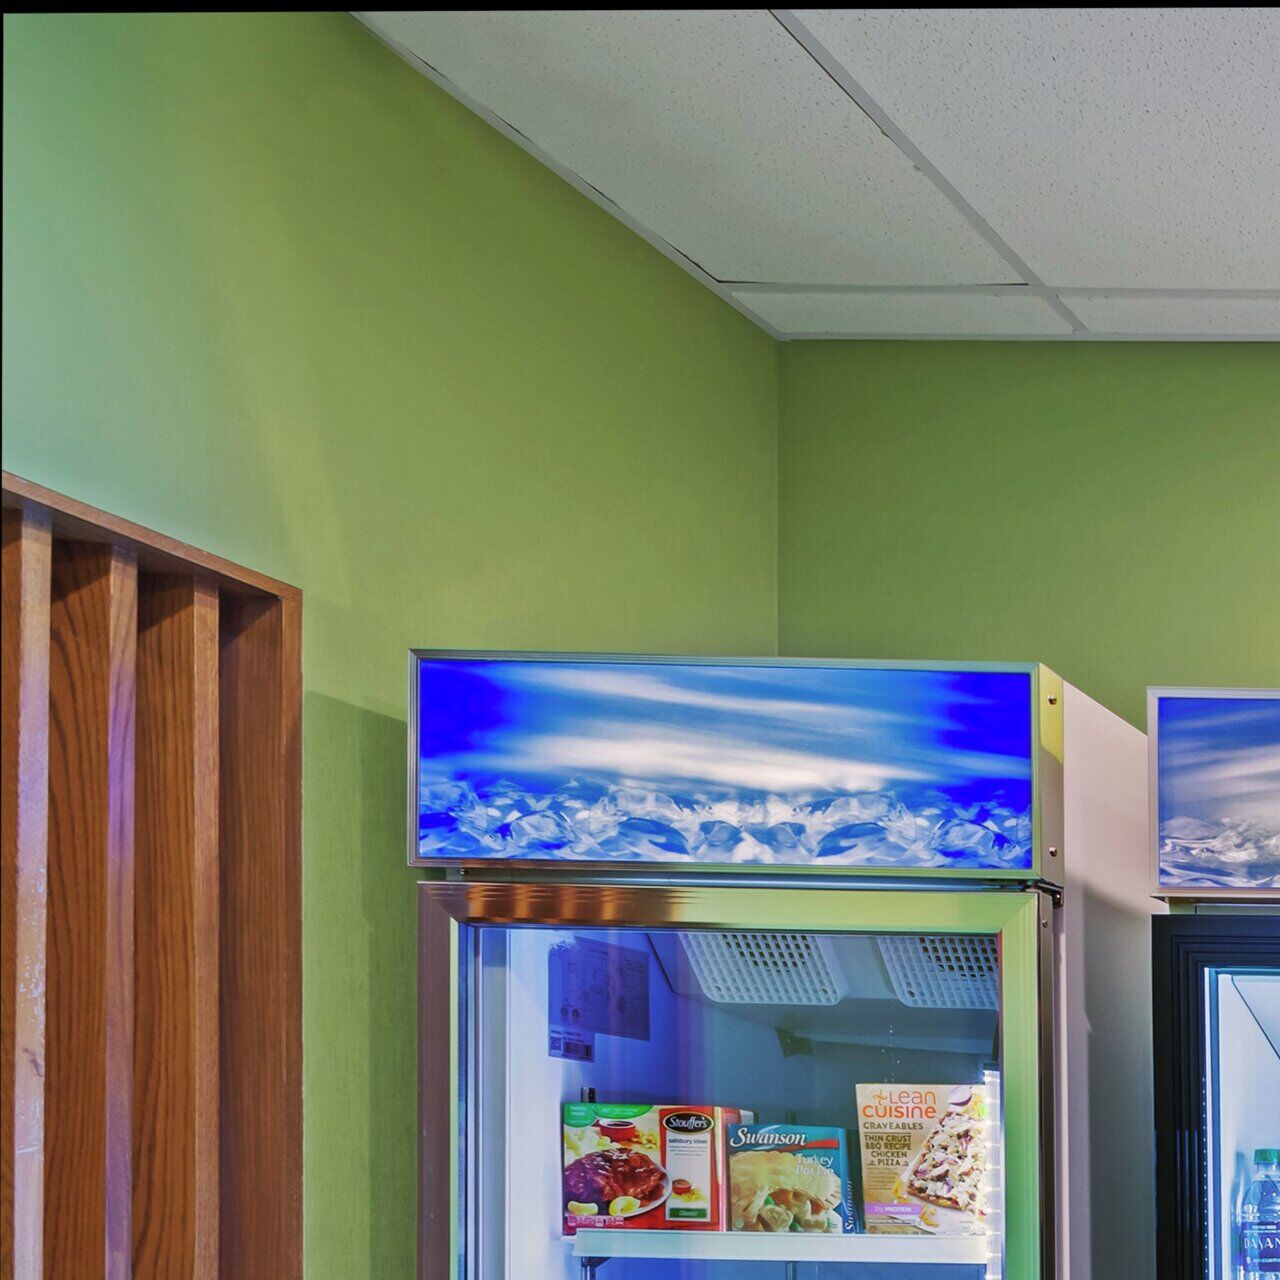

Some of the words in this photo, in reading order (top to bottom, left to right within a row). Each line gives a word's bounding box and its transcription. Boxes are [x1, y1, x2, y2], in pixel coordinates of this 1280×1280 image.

[889, 1090, 937, 1105] Lean
[669, 1115, 708, 1131] Stouffer's
[863, 1121, 924, 1130] CRAVEABLES
[730, 1127, 807, 1147] Swanson
[863, 1134, 884, 1142] THIN
[885, 1134, 912, 1142] CRUST
[865, 1142, 883, 1150] BBQ
[884, 1142, 911, 1150] RECIPE
[870, 1150, 908, 1158] CHICKEN
[795, 1153, 834, 1167] Turkey
